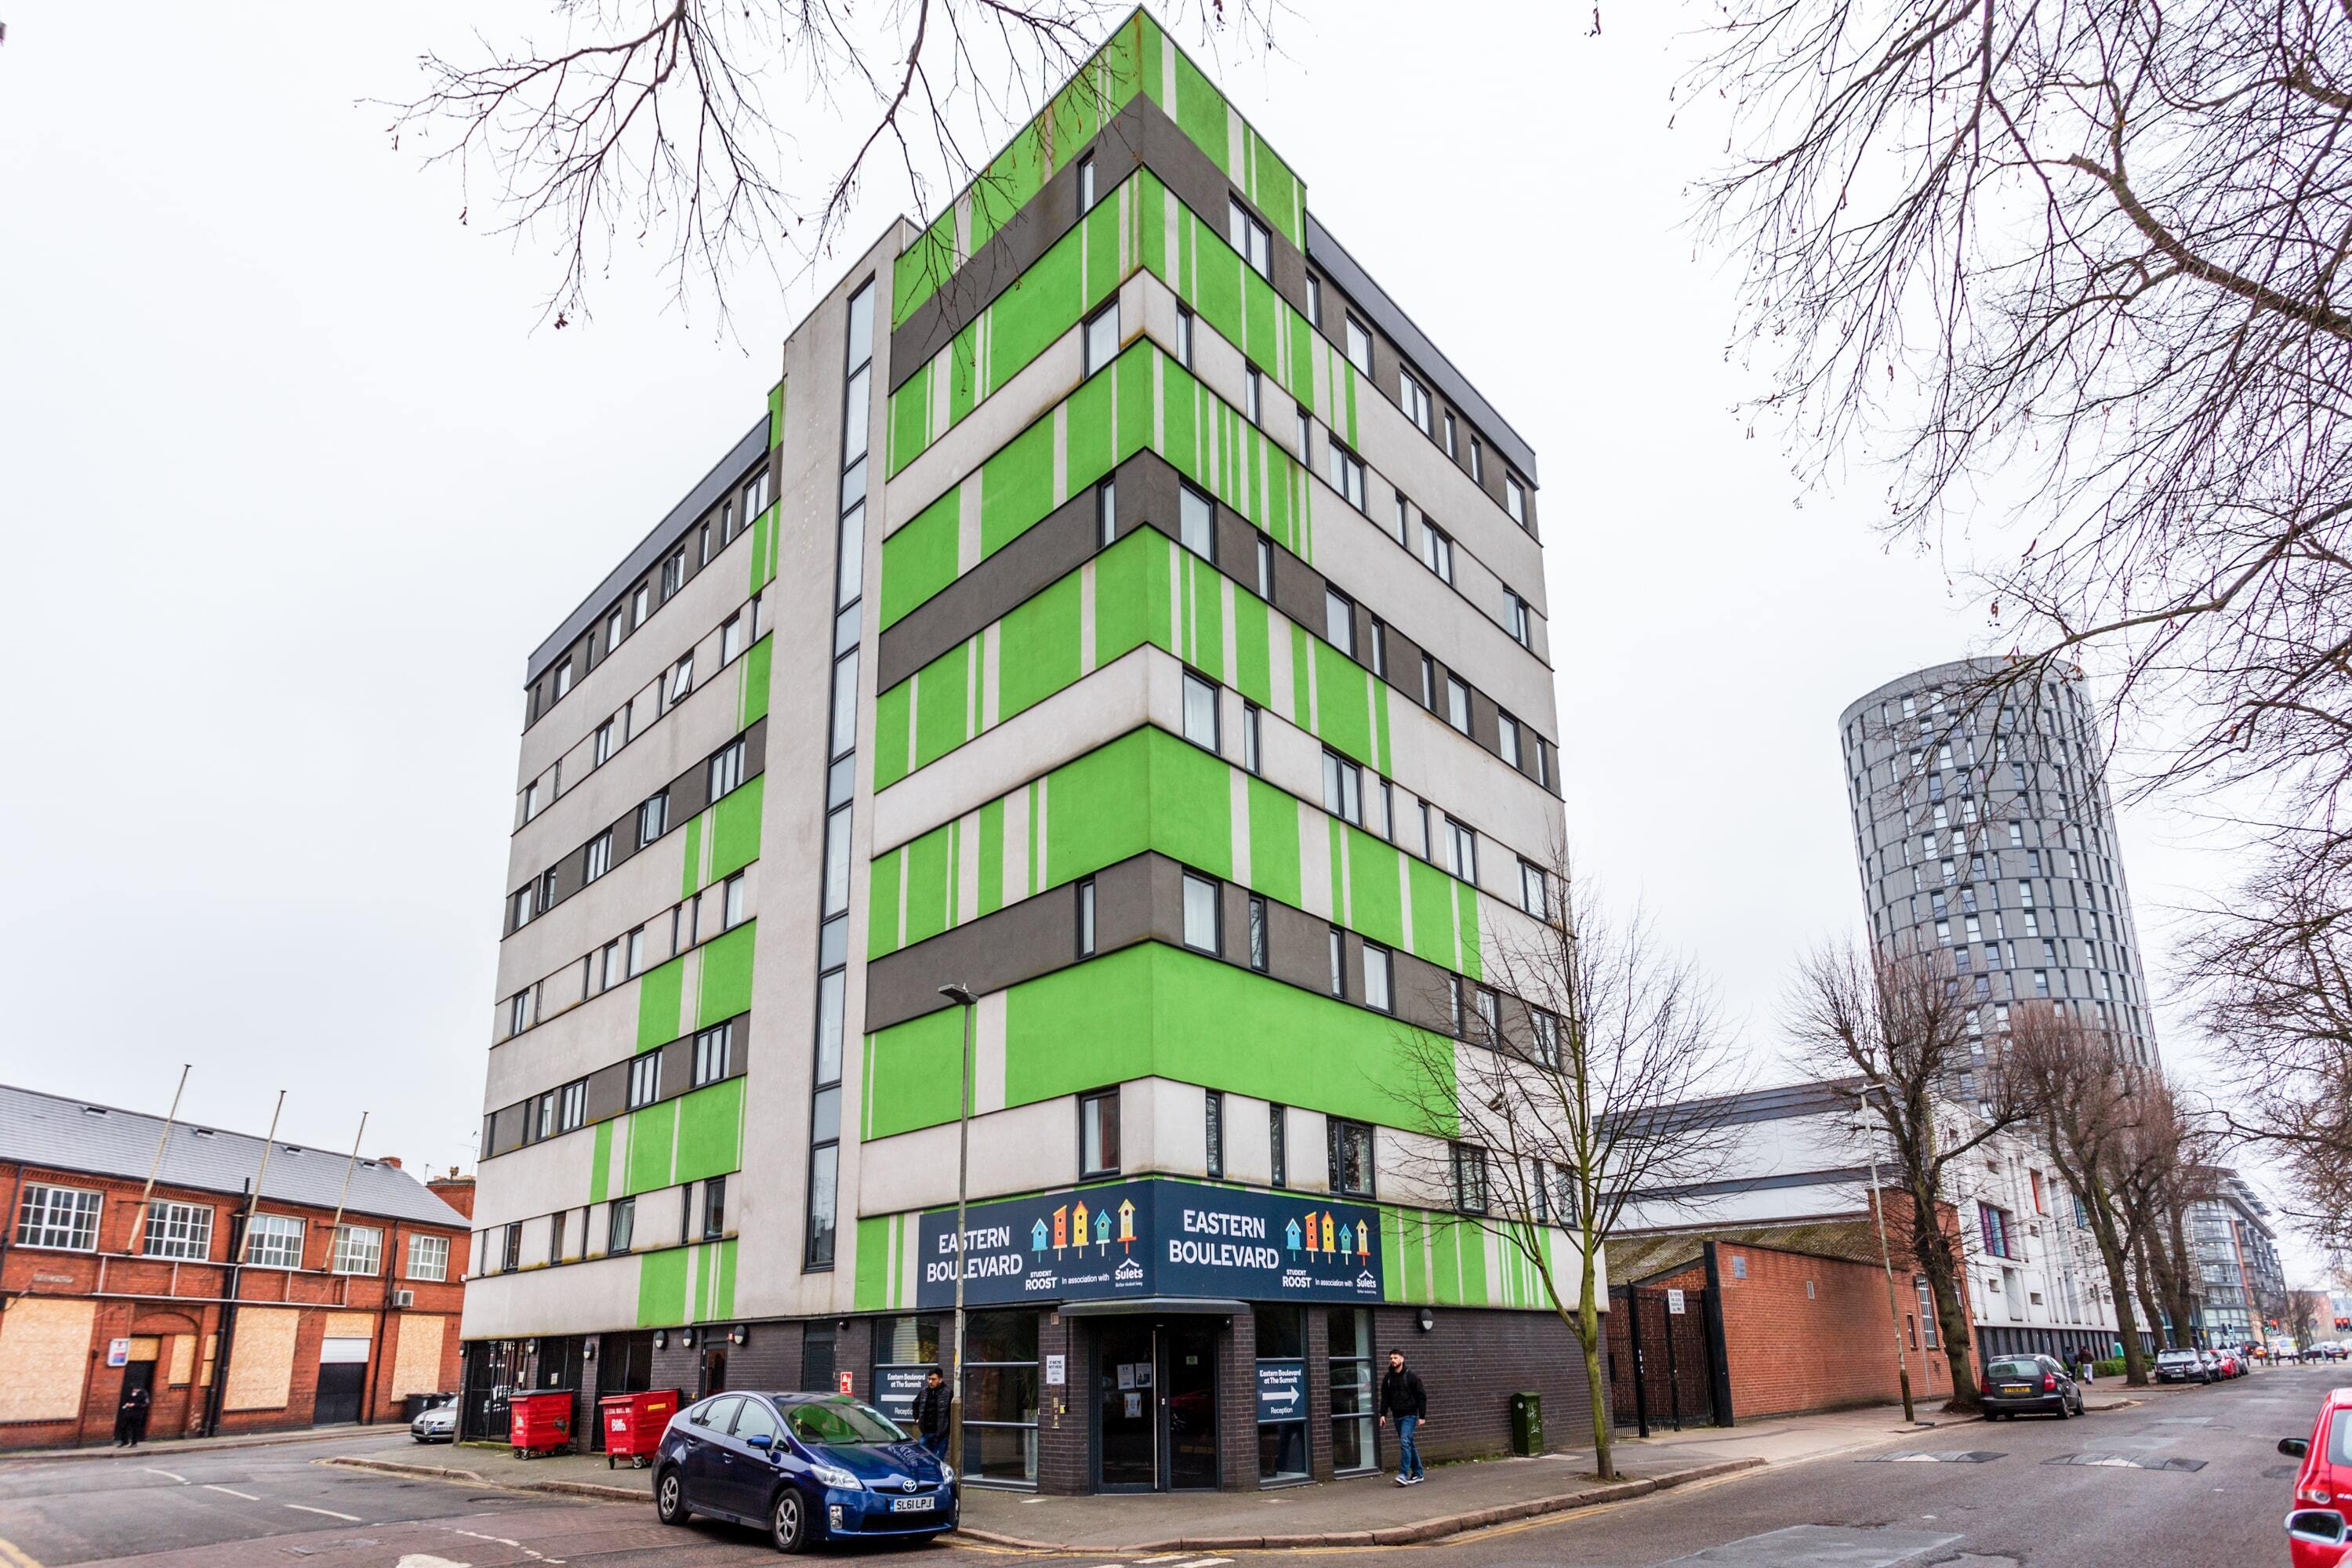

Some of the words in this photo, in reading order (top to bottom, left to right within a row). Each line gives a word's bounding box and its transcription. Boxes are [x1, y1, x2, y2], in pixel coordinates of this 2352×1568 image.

[1184, 1209, 1265, 1239] EASTERN
[1169, 1240, 1279, 1269] BOULEVARD
[1029, 1270, 1052, 1279] STUDENT
[1068, 1274, 1098, 1284] association
[1098, 1273, 1110, 1282] with
[1115, 1268, 1143, 1280] Sulets
[1025, 1276, 1058, 1290] ROOST
[1282, 1276, 1312, 1288] ROOST
[1356, 1277, 1377, 1288] Sulets
[894, 1406, 913, 1416] Receptio
[896, 1500, 914, 1510] SL61
[916, 1498, 931, 1508] LPJ
